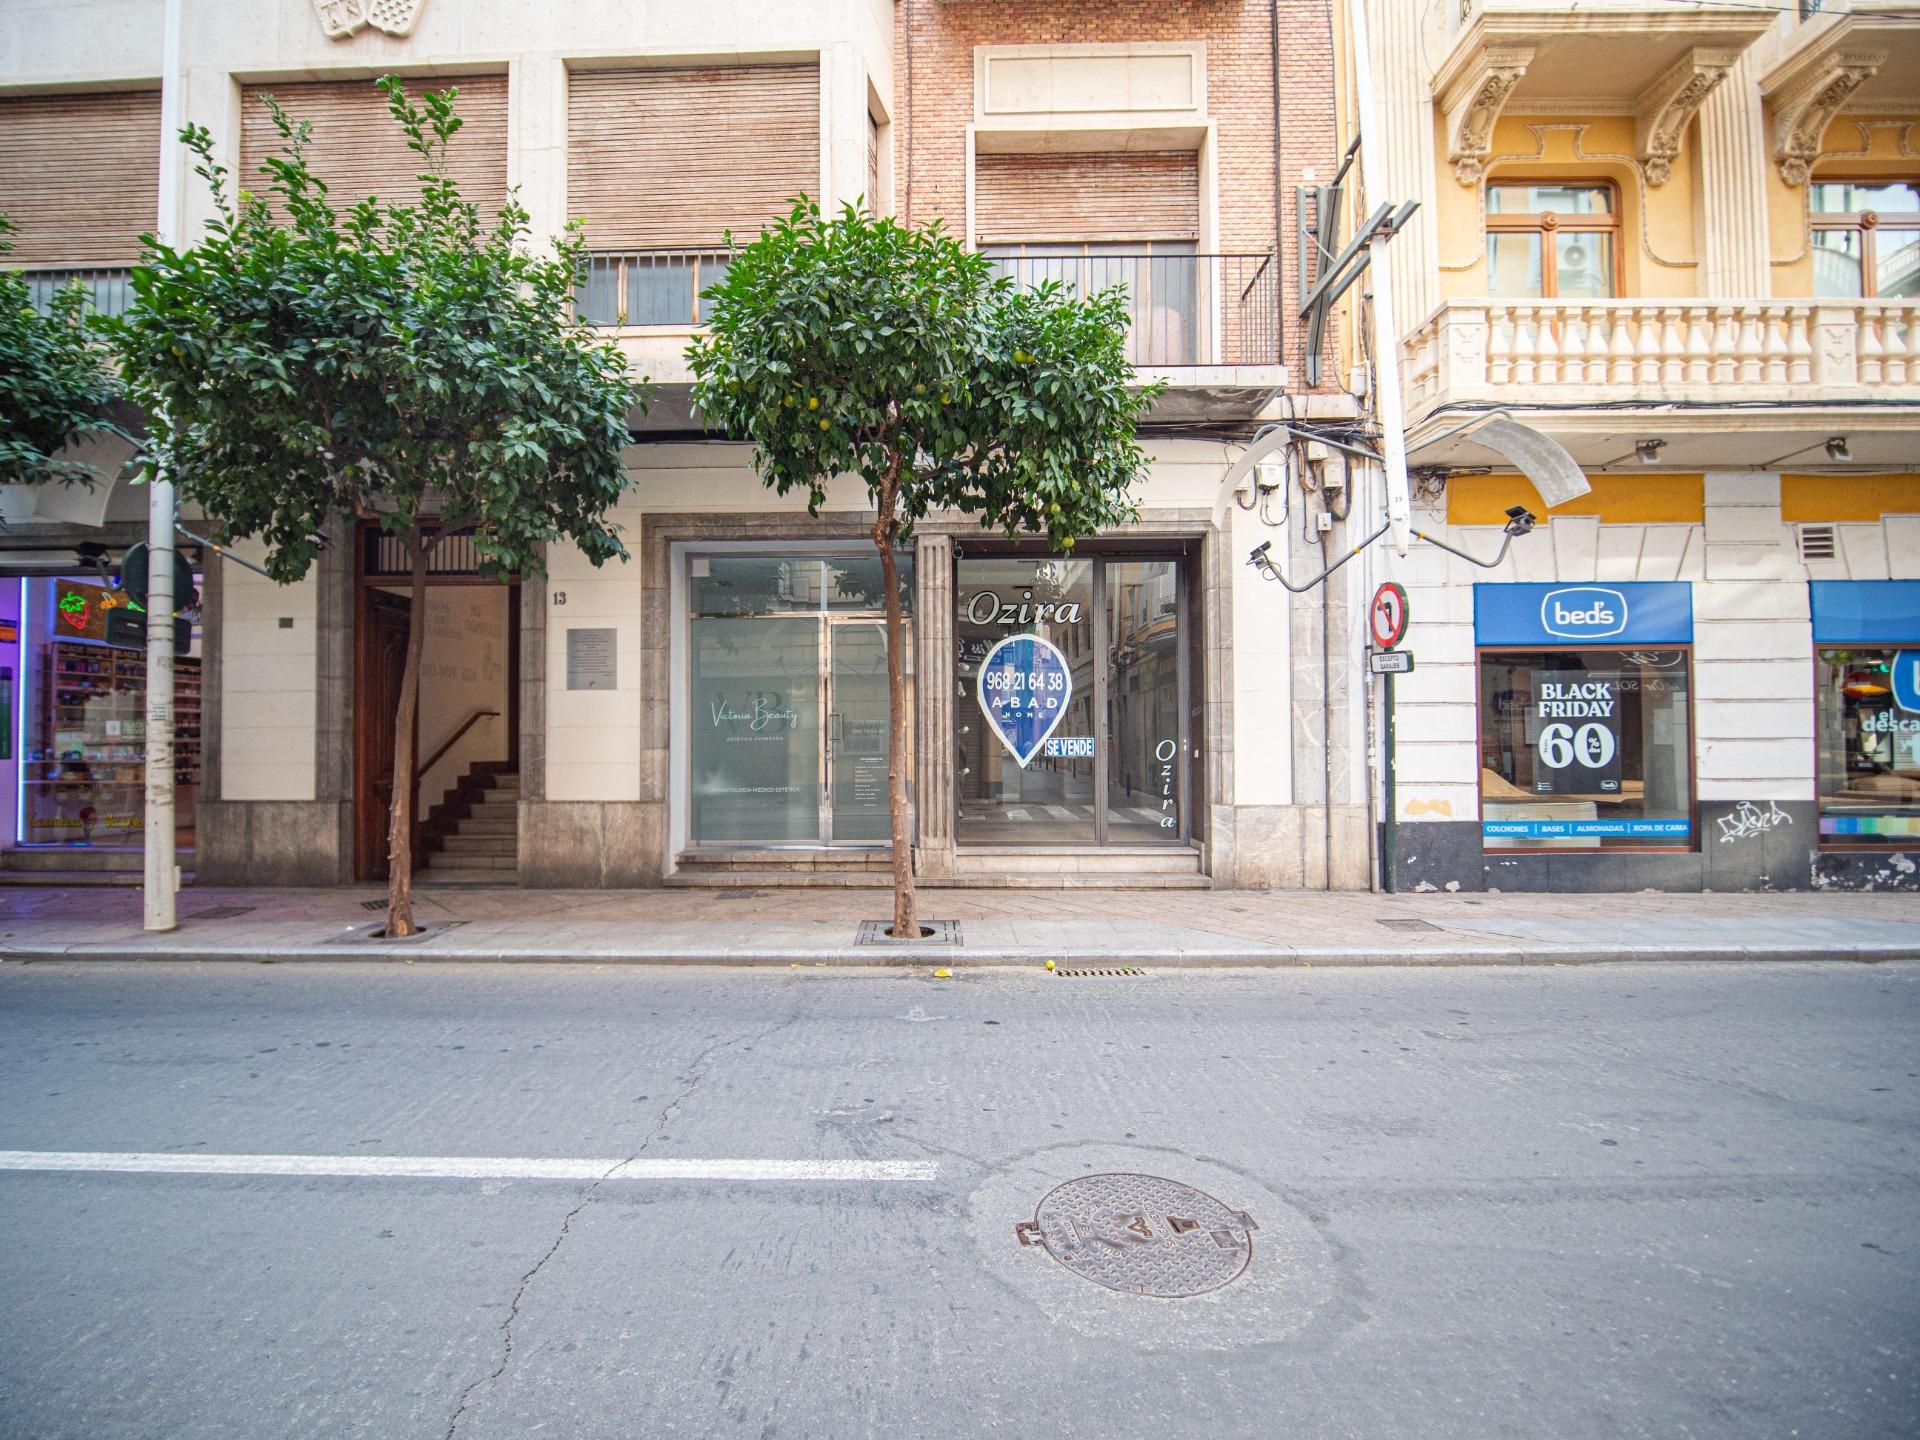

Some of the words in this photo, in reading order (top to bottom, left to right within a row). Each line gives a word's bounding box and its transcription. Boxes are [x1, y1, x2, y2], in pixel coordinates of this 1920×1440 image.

[553, 591, 567, 605] 13
[968, 590, 1082, 625] Ozira
[1554, 601, 1615, 625] bed's
[986, 672, 1010, 690] 968
[1013, 672, 1025, 690] 21
[1028, 672, 1044, 690] 64
[1047, 672, 1063, 690] 38
[1541, 683, 1612, 700] BLACK
[992, 696, 1058, 709] ABAD
[1538, 701, 1615, 718] FRIDAY
[750, 697, 798, 731] Beauty
[1879, 708, 1894, 721] el
[1047, 740, 1060, 755] SE
[1061, 739, 1092, 755] VENDE
[1538, 723, 1615, 769] 60
[1155, 739, 1176, 828] Ozira
[1486, 825, 1529, 833] COLCHONES
[1541, 825, 1565, 833] BASES
[1632, 824, 1653, 832] ROPA
[1654, 824, 1665, 832] DE
